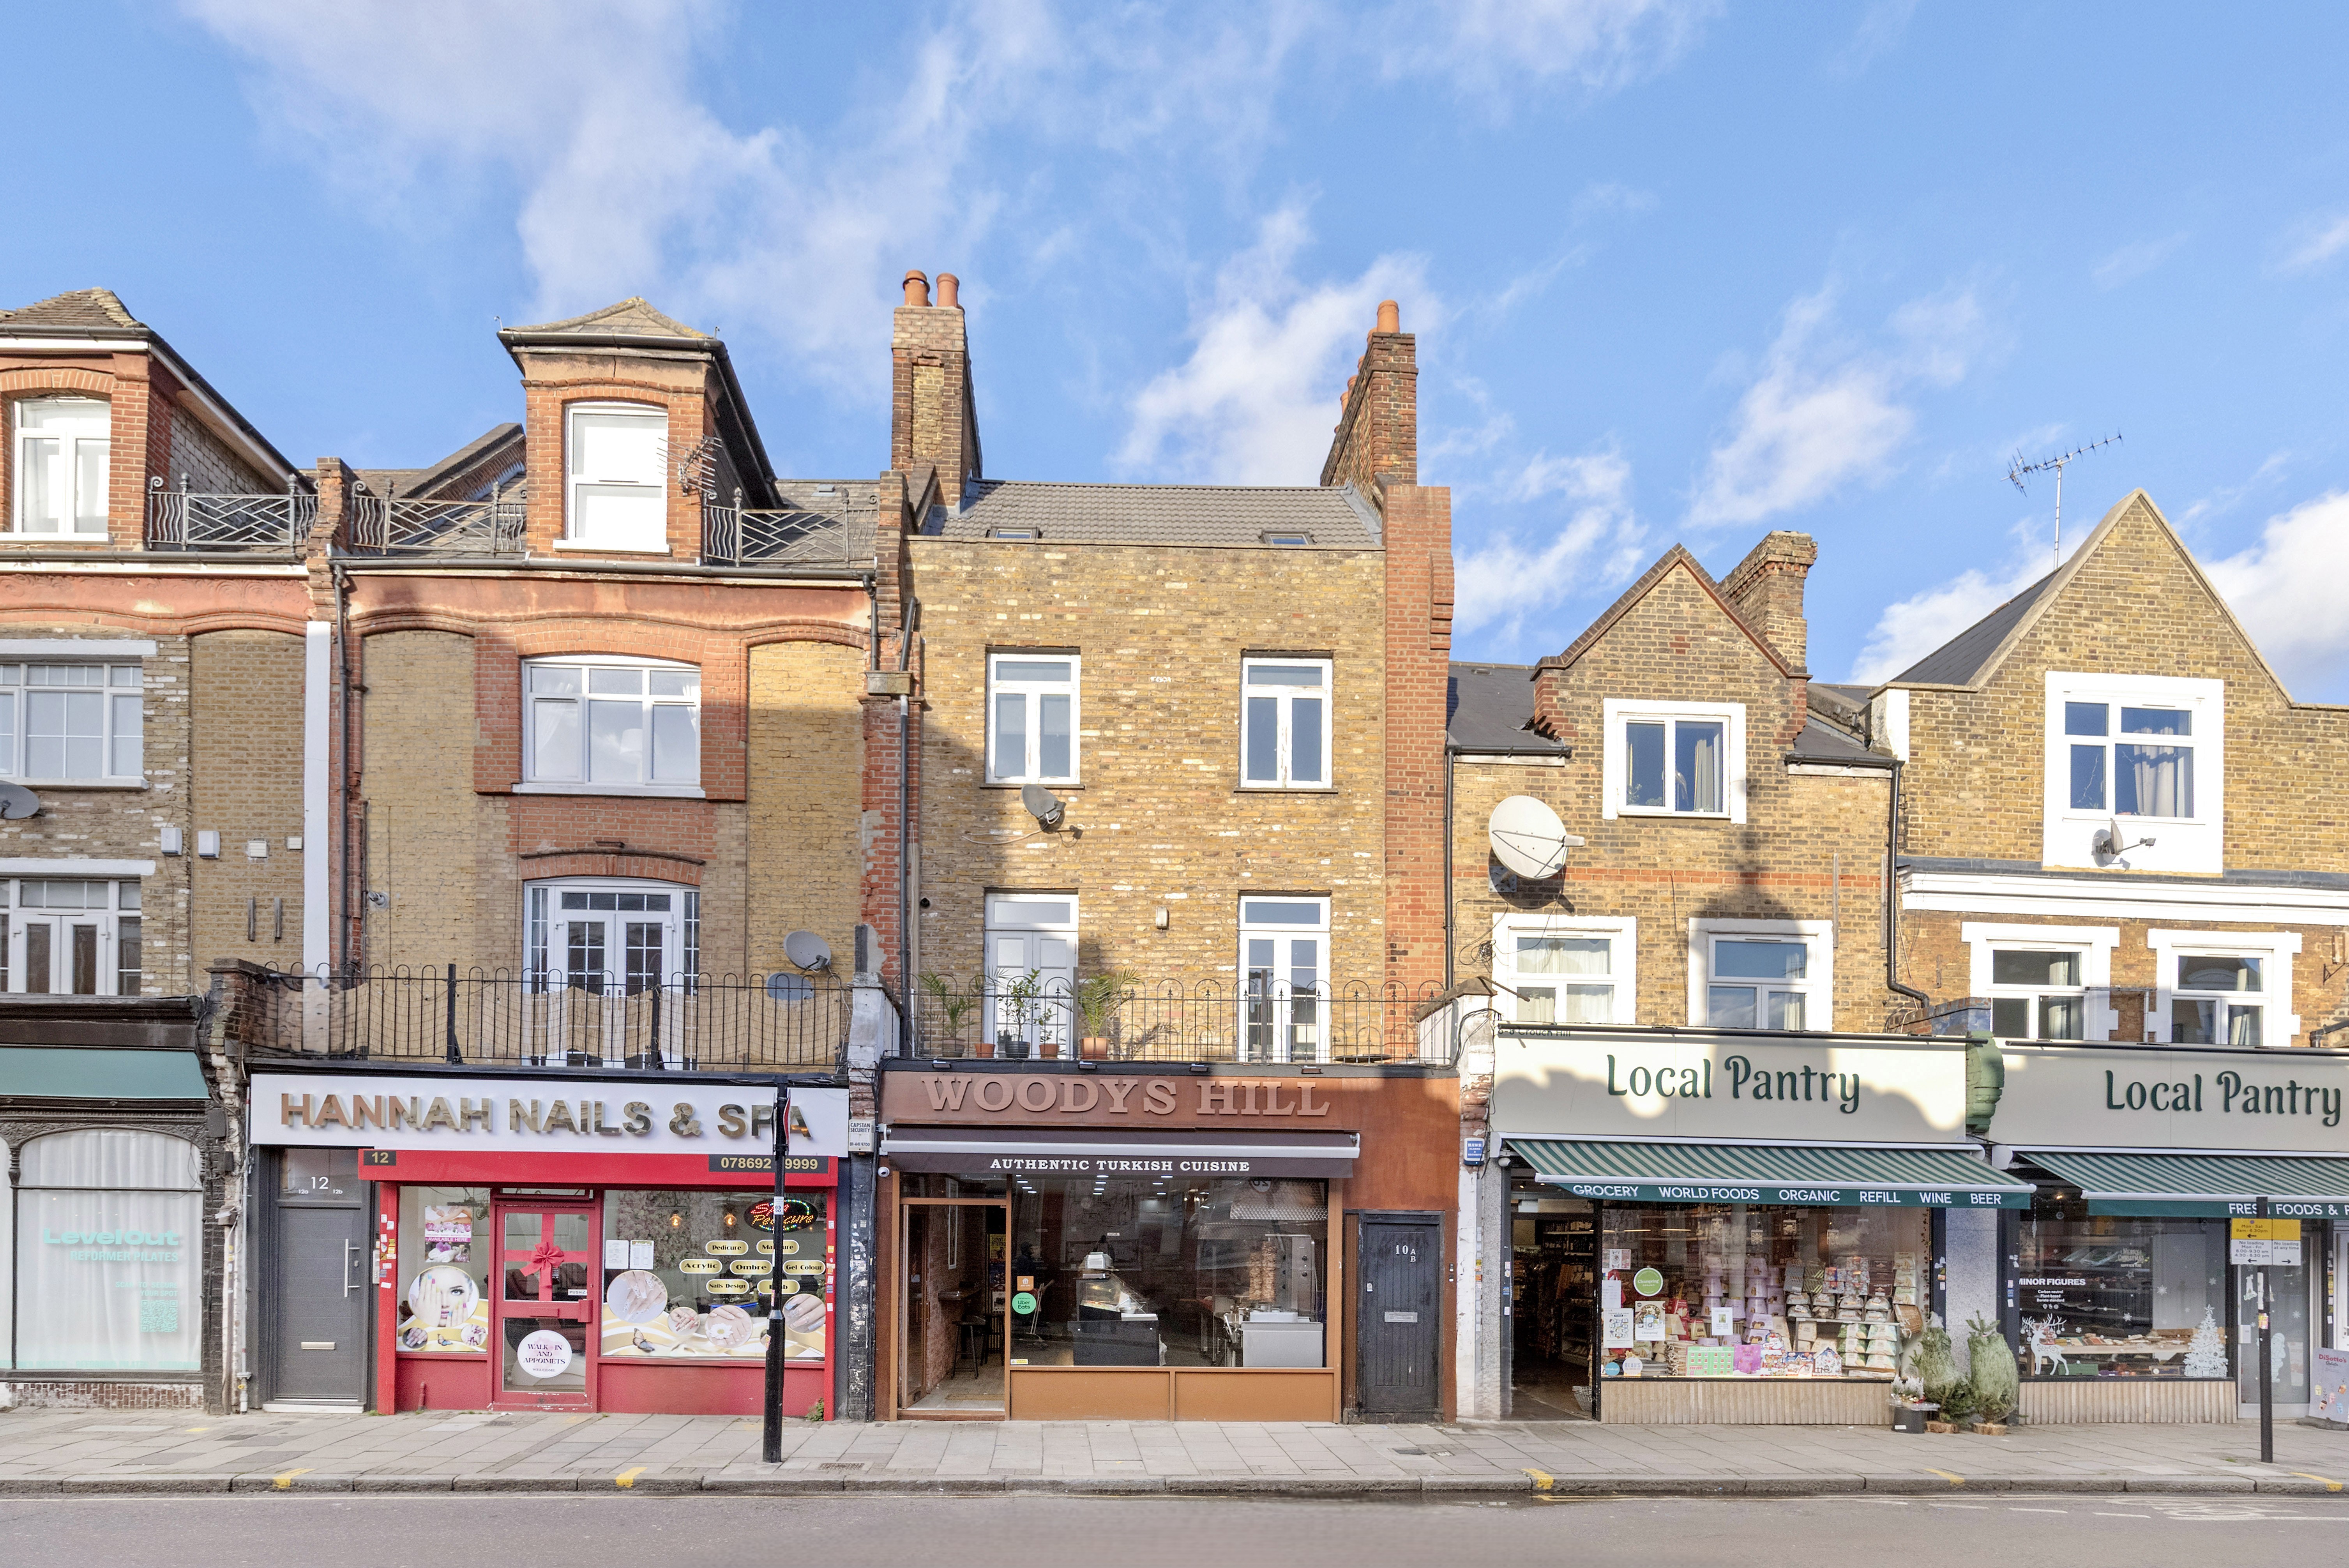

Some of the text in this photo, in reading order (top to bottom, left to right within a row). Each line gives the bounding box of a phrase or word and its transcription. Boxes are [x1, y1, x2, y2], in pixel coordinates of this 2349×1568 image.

[1607, 1054, 1860, 1114] Local Pantry
[921, 1076, 1330, 1116] WOODYS HILL
[2105, 1070, 2341, 1127] Local Pantry
[281, 1093, 493, 1131] HANNAH
[509, 1098, 653, 1135] NAILS
[669, 1102, 703, 1137] &
[371, 1152, 389, 1163] 12
[721, 1157, 818, 1170] 0786929999
[990, 1158, 1250, 1172] AUTHENTIC TURKISH CUISINE
[311, 1176, 329, 1189] 12
[1572, 1185, 2001, 1205] GROCERY WORLD FOODS ORGANIC REFILL WINE BEER
[2276, 1204, 2323, 1215] FOODS
[2328, 1204, 2338, 1215] &
[1395, 1245, 1409, 1254] 10
[70, 1251, 178, 1262] REFORMER PILATES
[2319, 1354, 2347, 1363] DiSotto's
